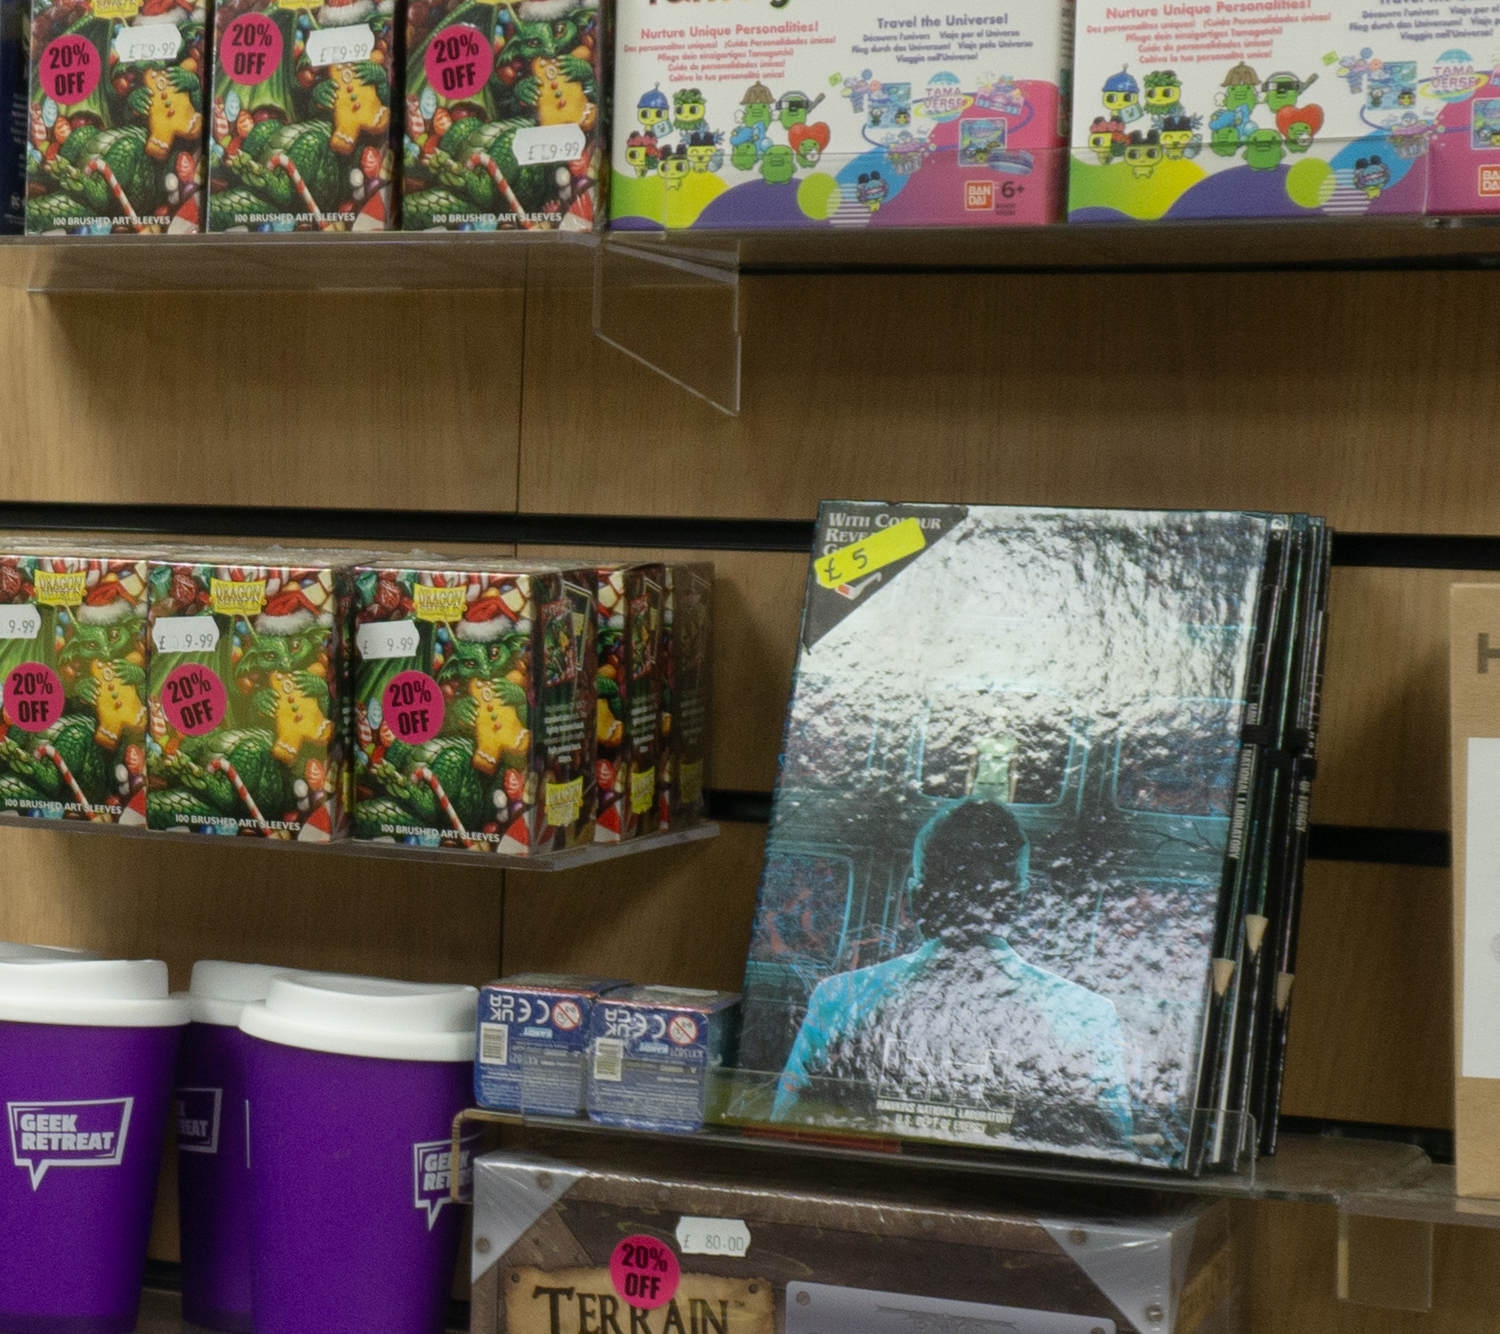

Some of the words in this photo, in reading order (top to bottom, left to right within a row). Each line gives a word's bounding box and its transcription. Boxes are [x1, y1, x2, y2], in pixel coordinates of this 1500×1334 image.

[640, 25, 688, 41] Nurture
[688, 22, 735, 40] Unique
[735, 20, 820, 38] Personalities!
[876, 14, 920, 30] Travel
[920, 14, 943, 29] the
[944, 11, 1010, 28] Universe!
[432, 37, 479, 68] 20%
[439, 62, 479, 93] OFF
[449, 212, 496, 223] BRUSHED
[498, 212, 517, 222] ART
[519, 211, 563, 222] SLEEVES
[388, 679, 434, 713] 20%
[394, 708, 432, 738] OFF
[18, 1112, 80, 1137] GEEK
[19, 1127, 116, 1153] RETREAT
[621, 1242, 669, 1272] 20%
[624, 1269, 662, 1300] OFF
